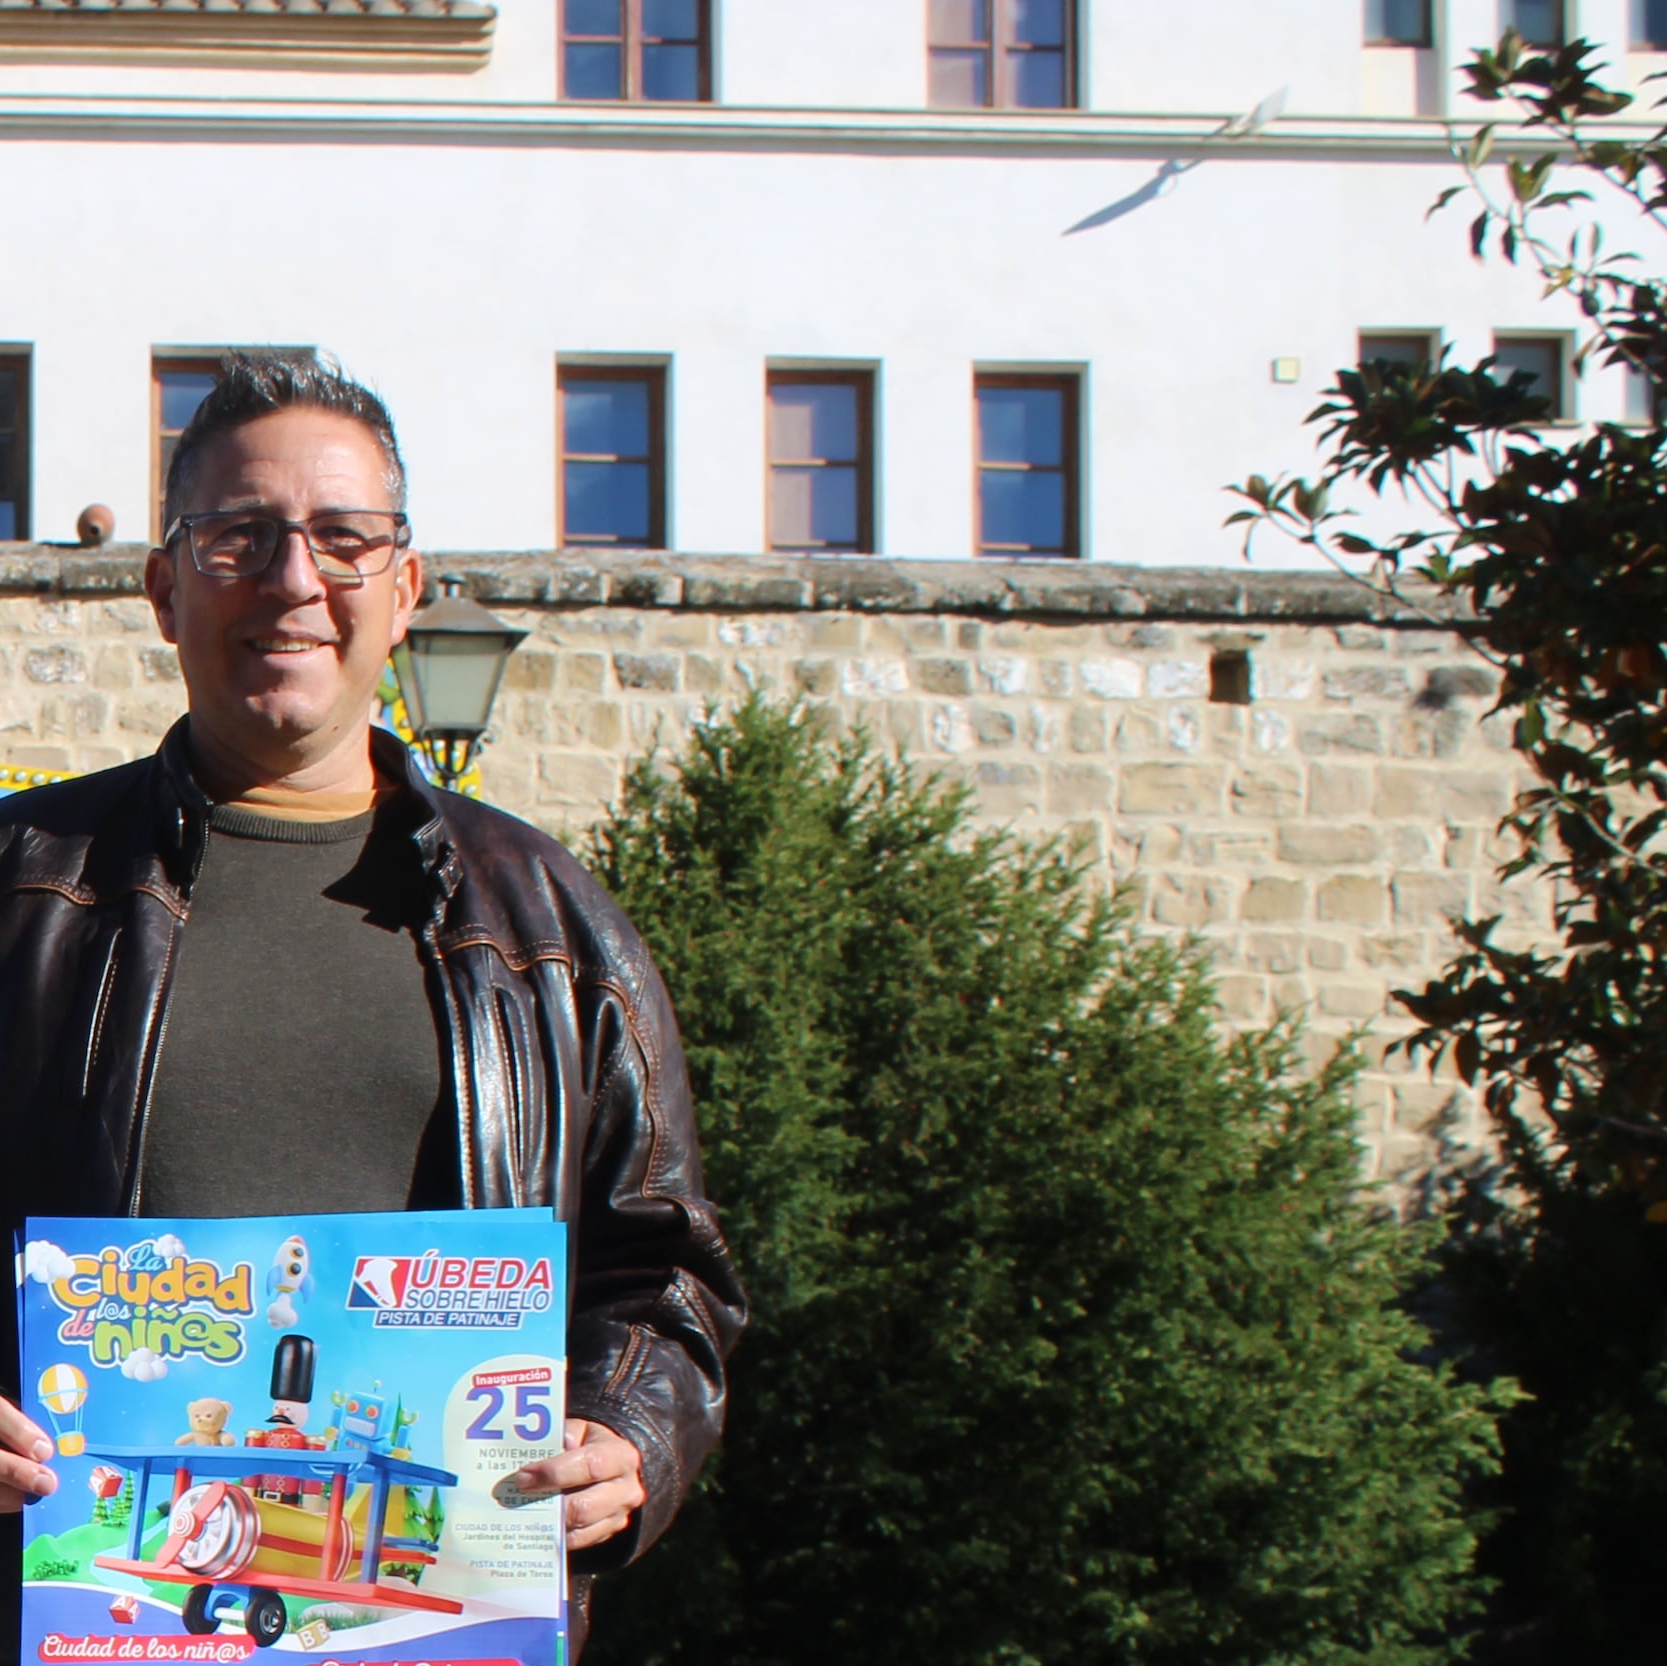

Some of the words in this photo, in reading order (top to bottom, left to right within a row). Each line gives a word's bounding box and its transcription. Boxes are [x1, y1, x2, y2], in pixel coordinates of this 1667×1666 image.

[130, 1244, 163, 1271] La
[411, 1250, 550, 1289] ÚBEDA
[53, 1250, 251, 1312] Ciudad
[97, 1298, 131, 1320] l@s
[405, 1289, 479, 1309] SOBRE
[484, 1290, 550, 1309] HIELO
[63, 1309, 94, 1337] de
[378, 1312, 421, 1325] PISTA
[423, 1312, 445, 1325] DE
[447, 1312, 518, 1326] PATINAJE
[94, 1305, 240, 1361] niñ@s
[475, 1369, 549, 1387] Inauguración
[465, 1386, 552, 1441] 25
[479, 1448, 555, 1459] NOVIEMBRE
[43, 1635, 115, 1658] Ciudad
[118, 1638, 145, 1658] de
[147, 1638, 182, 1659] los
[184, 1641, 250, 1663] niñ@s
